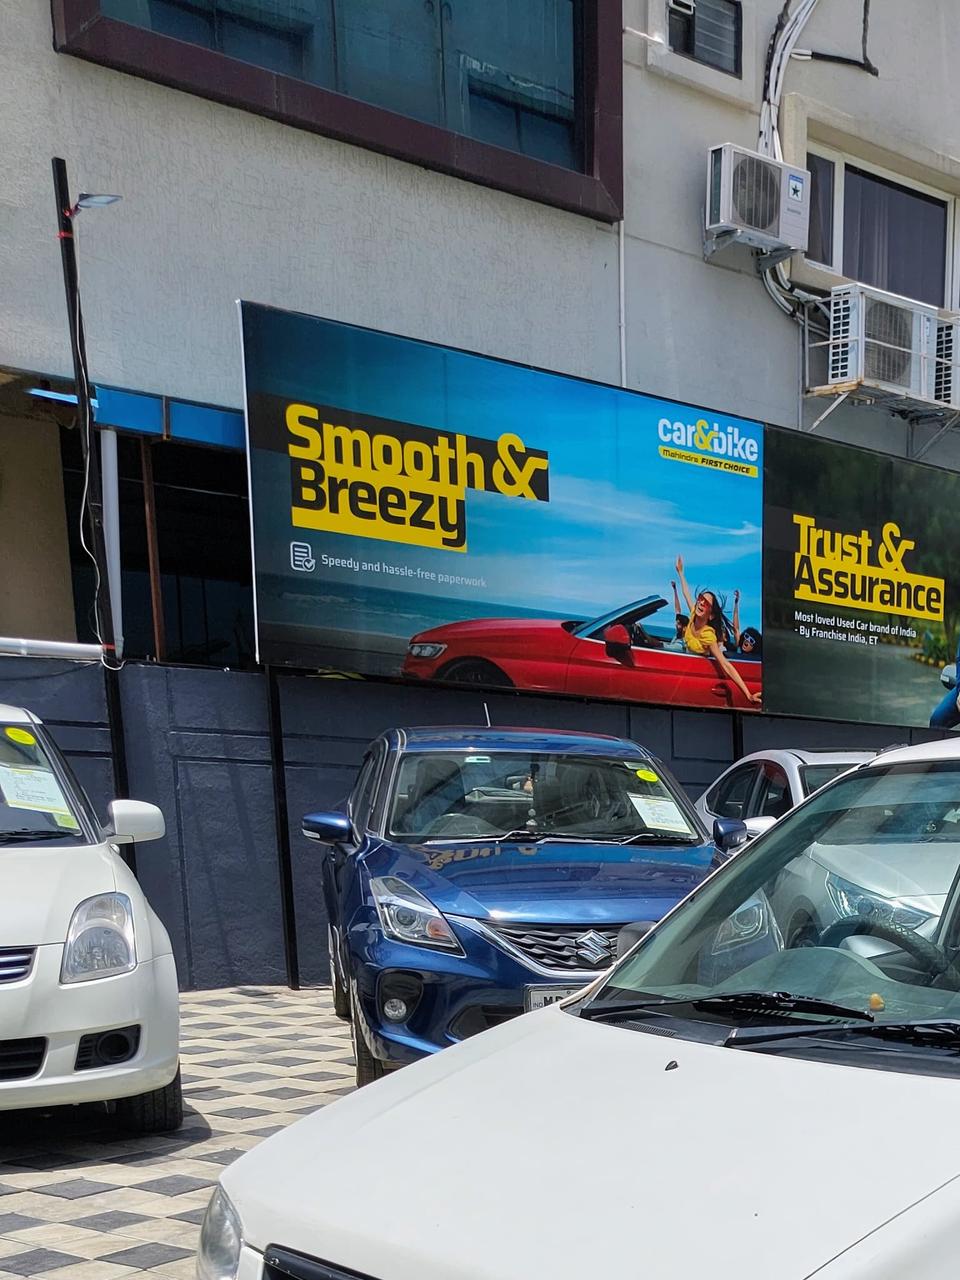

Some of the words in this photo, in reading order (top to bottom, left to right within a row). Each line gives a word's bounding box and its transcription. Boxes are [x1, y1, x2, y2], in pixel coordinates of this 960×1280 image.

[285, 403, 485, 490] Smooth
[492, 432, 548, 501] &
[658, 418, 758, 462] car&bike
[701, 458, 723, 468] FIRST
[723, 462, 750, 474] CHOICE
[291, 459, 466, 547] Breezy
[793, 514, 872, 567] Trust
[878, 522, 915, 574] &
[321, 554, 359, 572] Speedy
[361, 561, 381, 573] and
[382, 563, 436, 581] hassle-free
[437, 573, 487, 588] paperwork
[794, 554, 941, 614] Assurance
[794, 610, 814, 623] Most
[815, 613, 835, 626] loved
[836, 617, 855, 629] Used
[856, 620, 868, 631] Car
[869, 621, 890, 635] brand
[890, 625, 899, 635] of
[899, 626, 917, 638] India
[799, 625, 810, 638] By
[811, 627, 847, 641] Franchise
[847, 633, 868, 645] India,
[868, 635, 879, 645] ET
